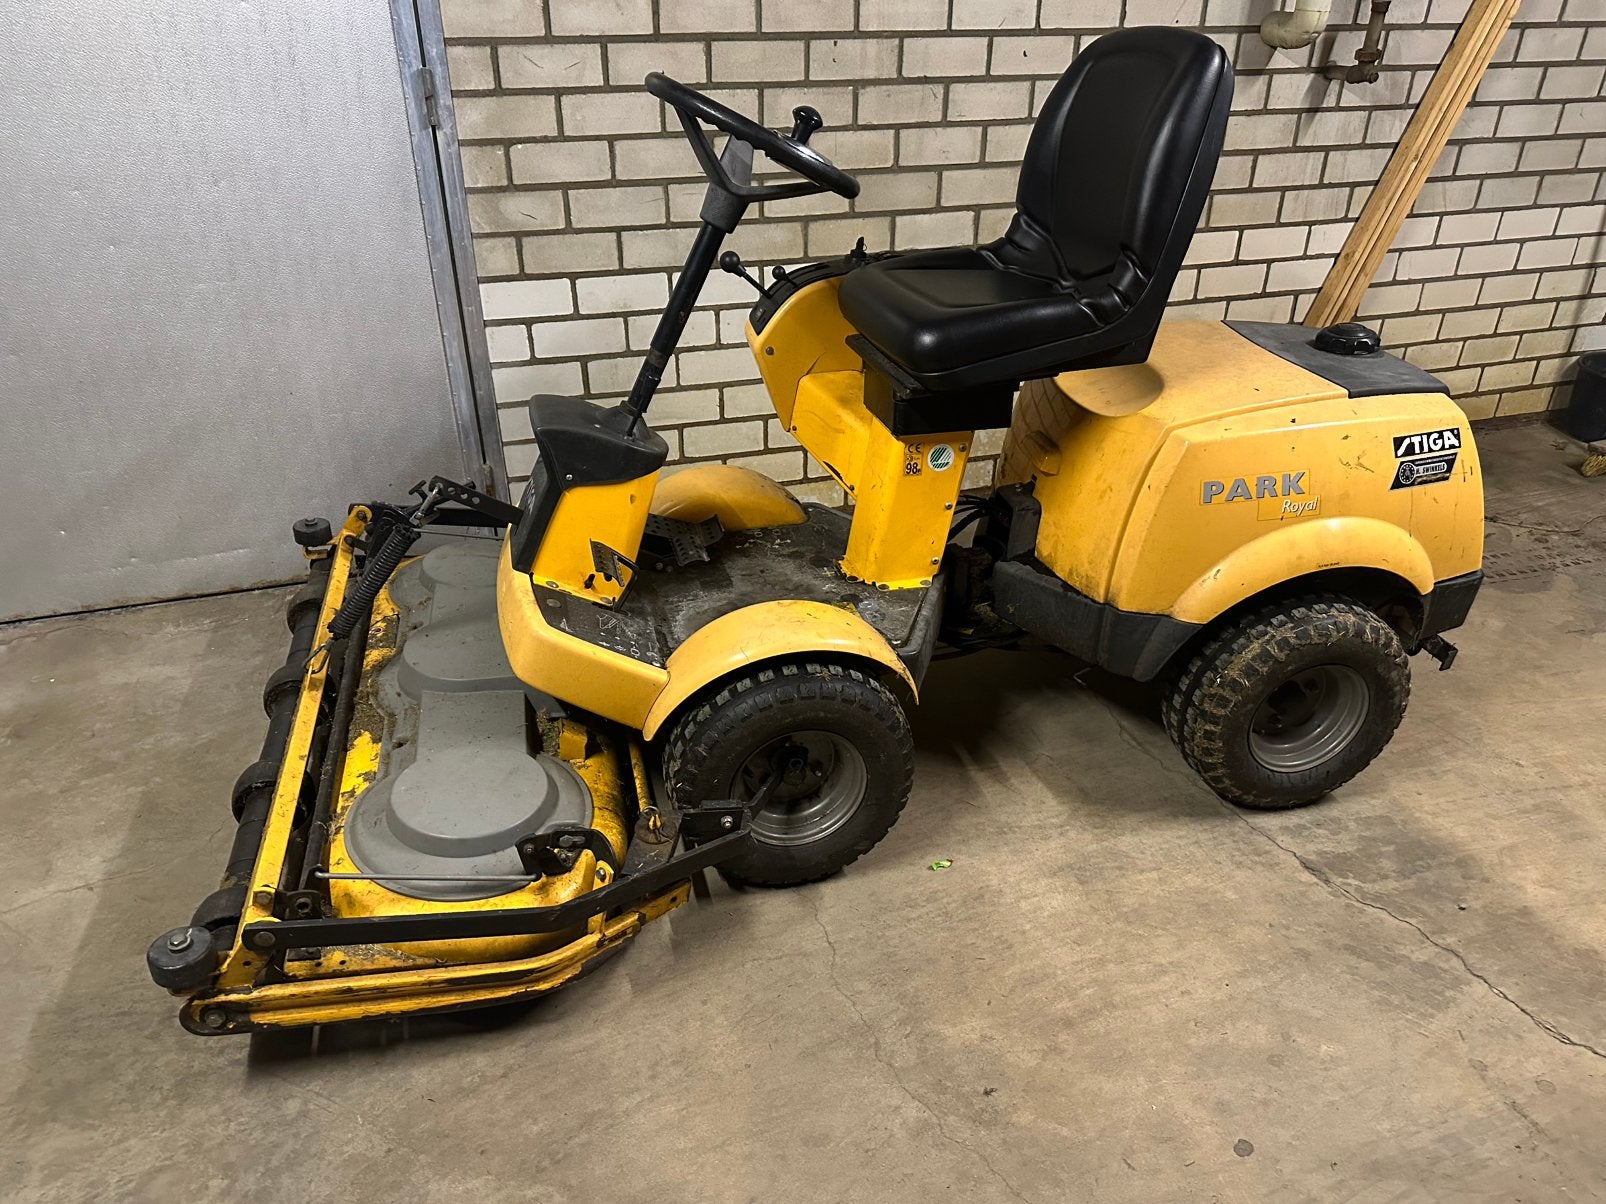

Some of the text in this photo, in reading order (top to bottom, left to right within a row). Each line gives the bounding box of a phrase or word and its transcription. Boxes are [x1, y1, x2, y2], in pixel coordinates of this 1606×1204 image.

[1396, 430, 1460, 457] STIGA
[1202, 471, 1306, 504] PARK
[1281, 496, 1319, 516] Royal
